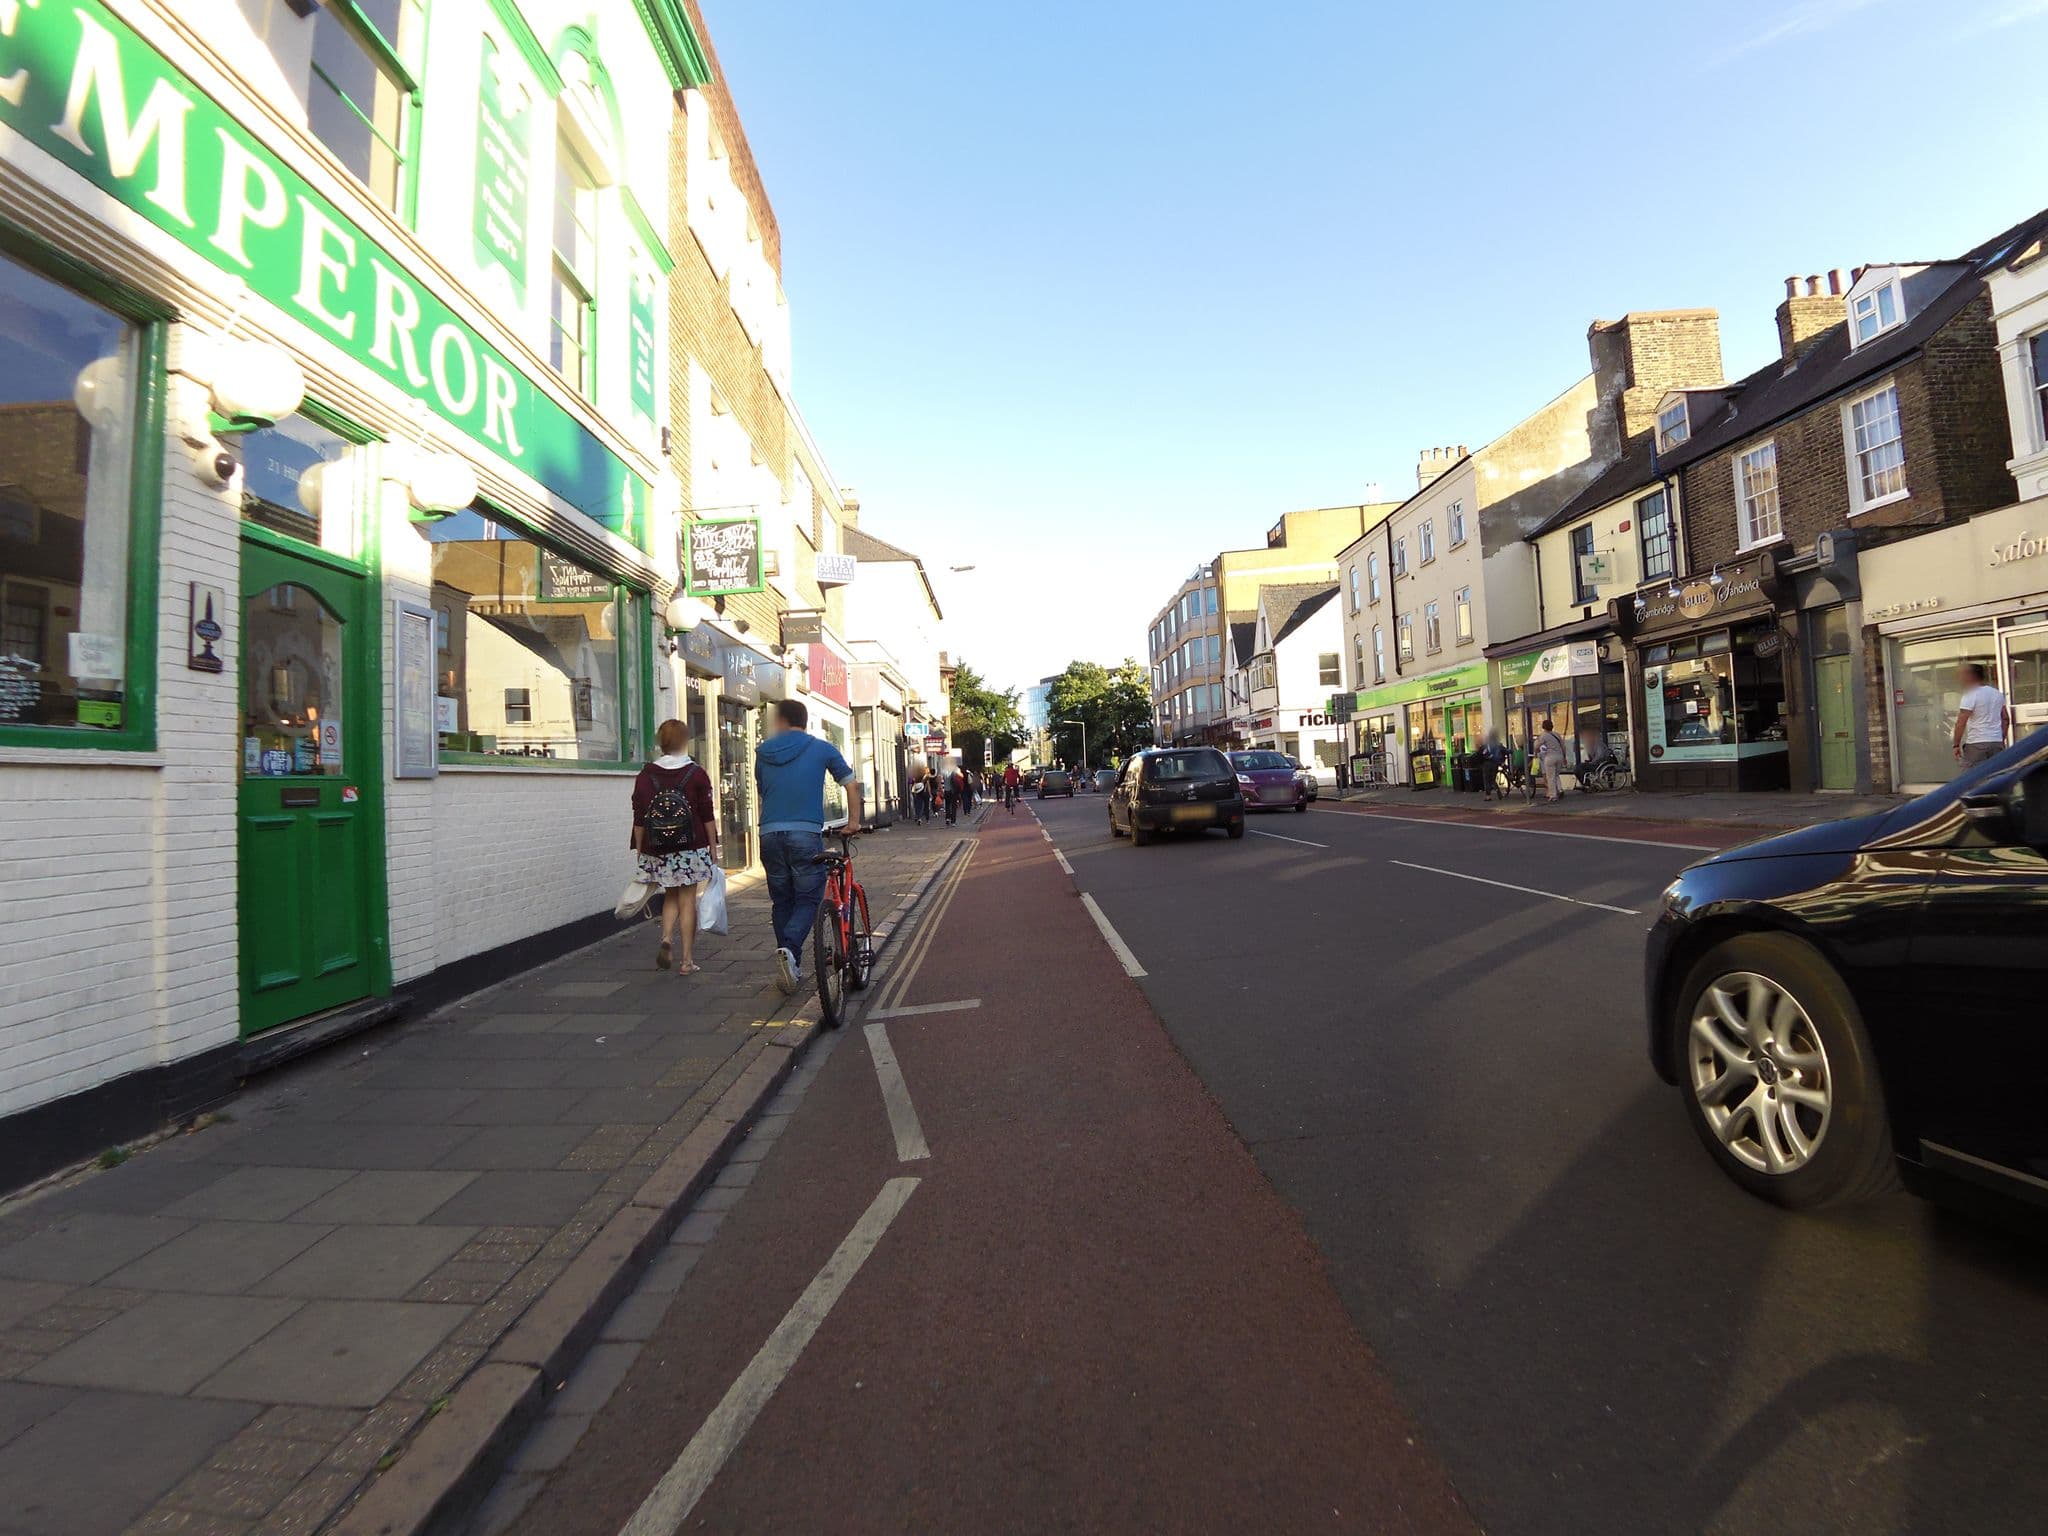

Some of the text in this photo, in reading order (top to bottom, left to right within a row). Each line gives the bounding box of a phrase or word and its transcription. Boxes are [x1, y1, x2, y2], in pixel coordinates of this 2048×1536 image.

[819, 556, 853, 568] ABBEY
[1634, 604, 1675, 624] Cambridge
[1685, 592, 1708, 608] BLUE
[1758, 636, 1778, 652] BLUE
[1299, 708, 1338, 726] rich
[270, 750, 287, 760] FREE
